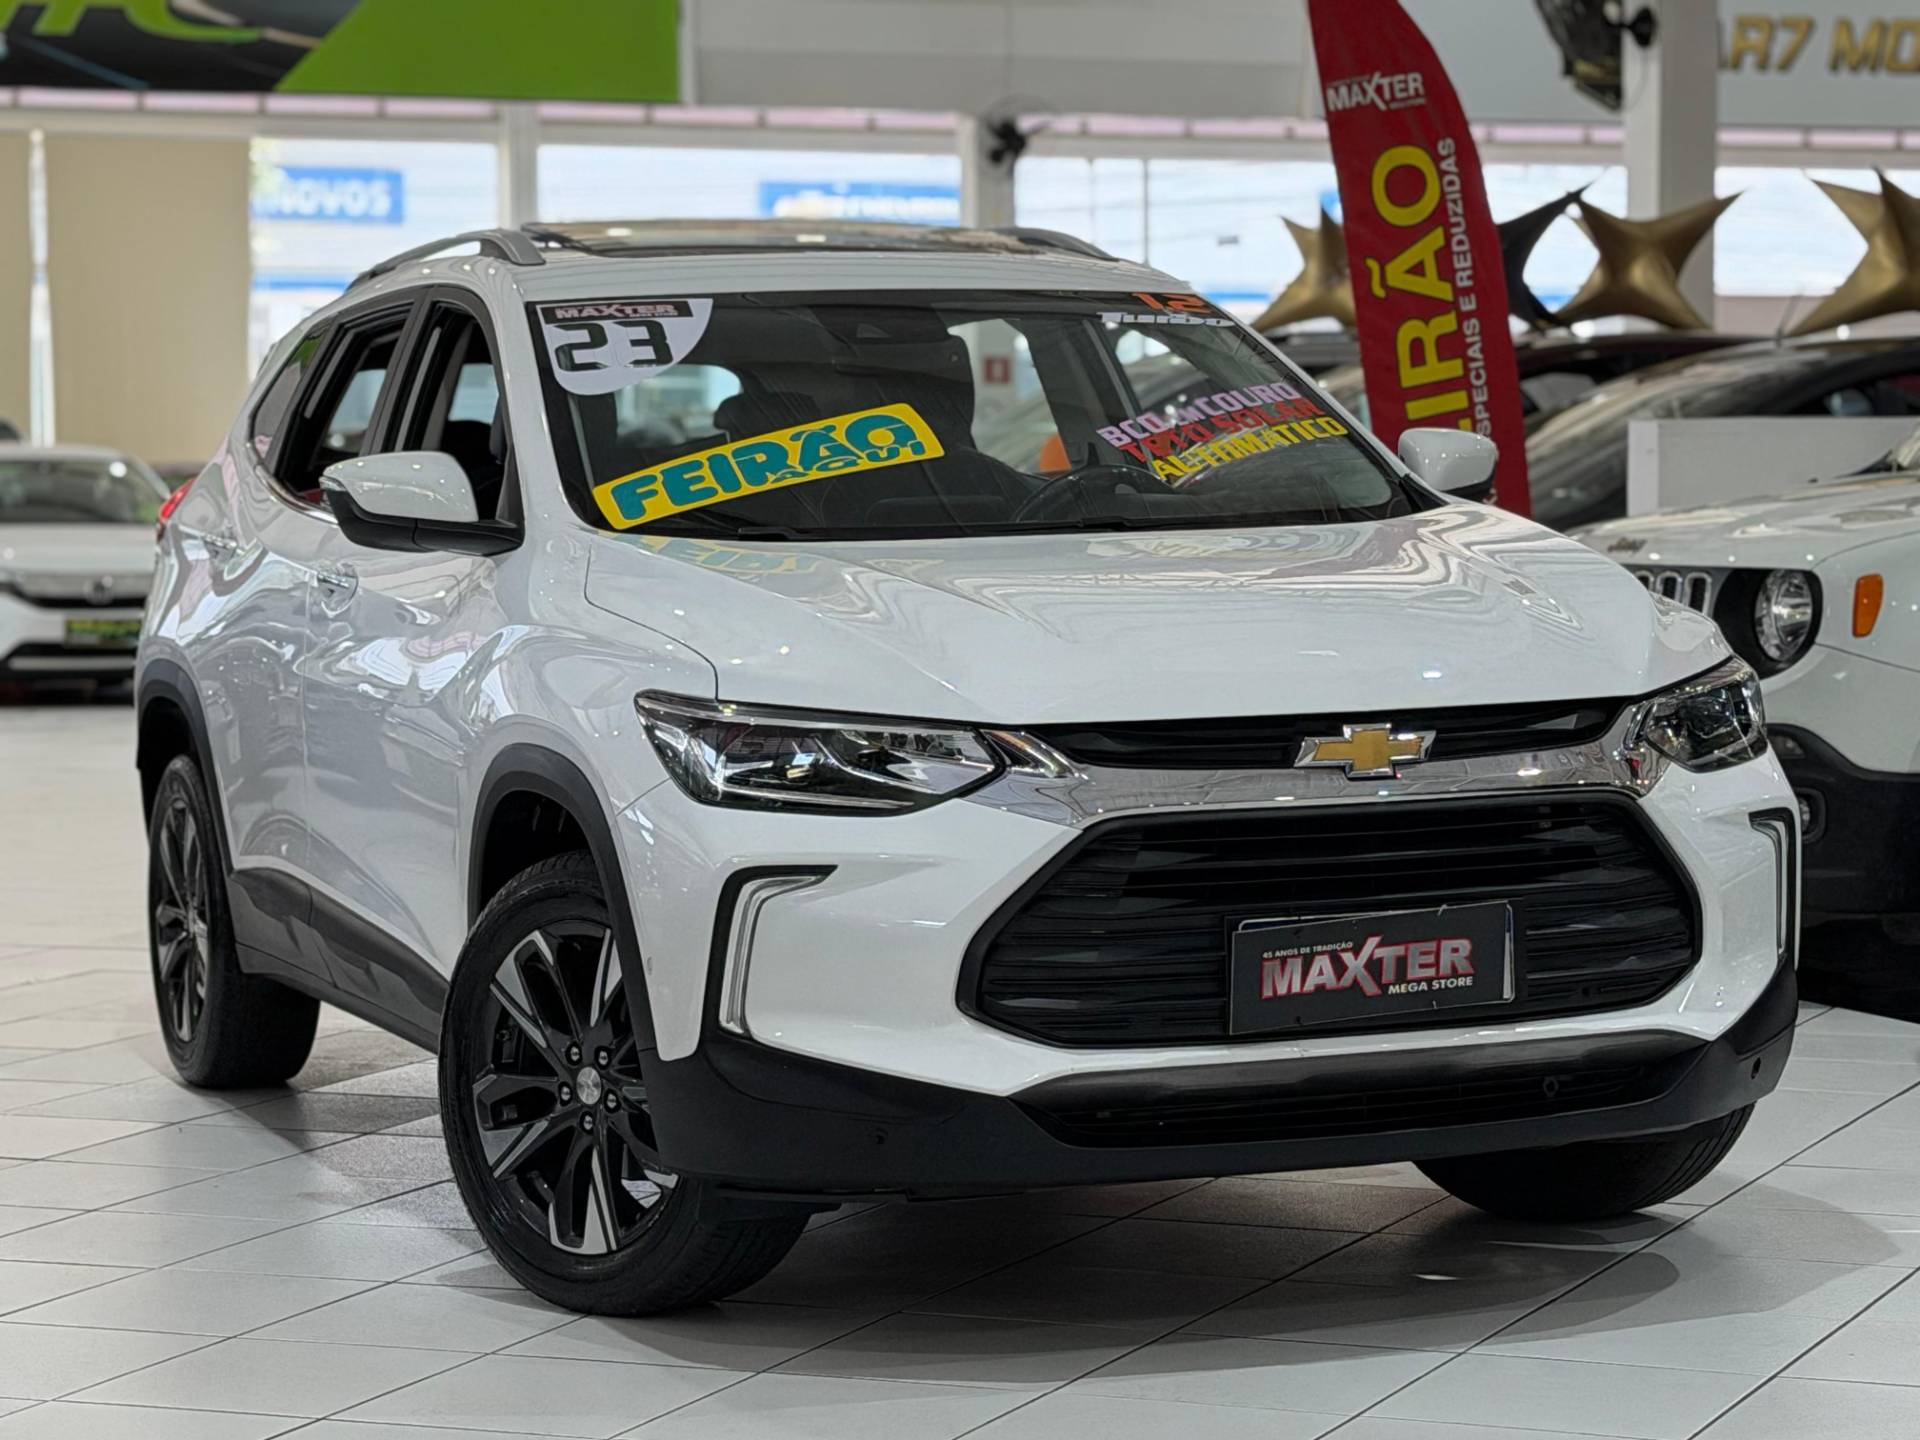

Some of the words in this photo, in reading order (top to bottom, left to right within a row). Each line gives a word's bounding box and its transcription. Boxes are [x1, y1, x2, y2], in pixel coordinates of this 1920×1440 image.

[1326, 70, 1425, 112] MAXTER
[1436, 137, 1474, 288] REDUZIDAS
[554, 304, 676, 319] MAXTER
[1364, 144, 1472, 432] IRÃO
[1459, 293, 1477, 311] E
[553, 319, 674, 373] 23
[1195, 382, 1302, 414] COURO
[1462, 317, 1491, 438] SPECIAIS
[610, 413, 918, 521] FEIRÃO
[1261, 935, 1474, 999] MAXTER
[1275, 947, 1299, 957] ANOS
[1300, 946, 1311, 954] DE
[1387, 982, 1429, 995] MEGA
[1431, 976, 1474, 991] STORE
